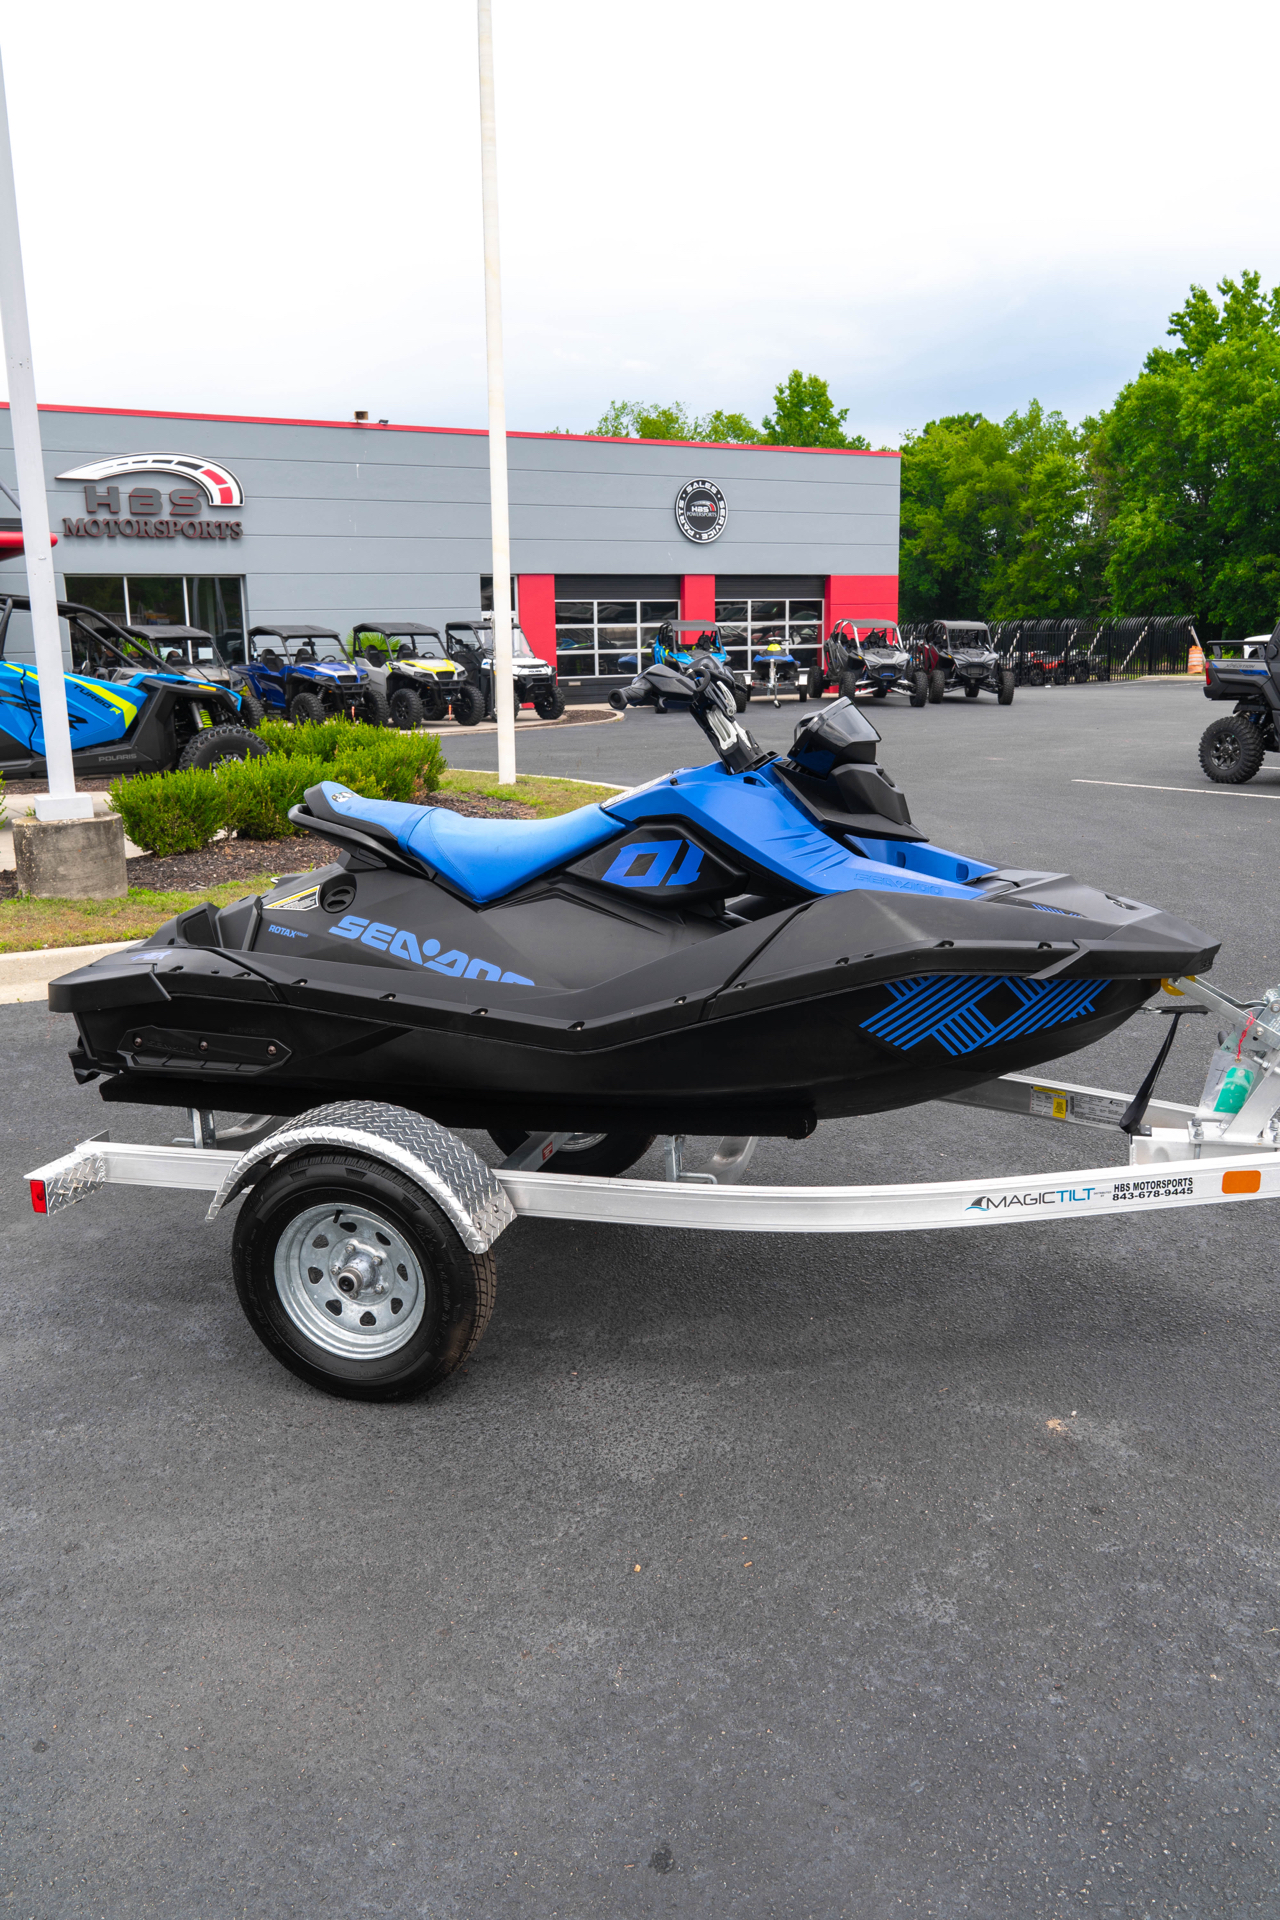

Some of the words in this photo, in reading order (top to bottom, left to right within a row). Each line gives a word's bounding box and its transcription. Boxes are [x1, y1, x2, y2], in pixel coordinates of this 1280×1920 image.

[686, 481, 717, 493] SALES
[84, 485, 203, 515] HBS
[62, 517, 244, 539] MOTORSPORTS
[678, 499, 695, 537] PARTS
[701, 500, 726, 540] SERVICE
[74, 684, 112, 709] TURBO
[98, 753, 138, 762] POLARIS
[268, 924, 297, 939] ROTAX
[1112, 1187, 1194, 1201] 843-678-9445
[1113, 1183, 1131, 1193] HBS
[1132, 1177, 1194, 1191] MOTORSPORTS
[986, 1187, 1096, 1209] MAGICTILT
